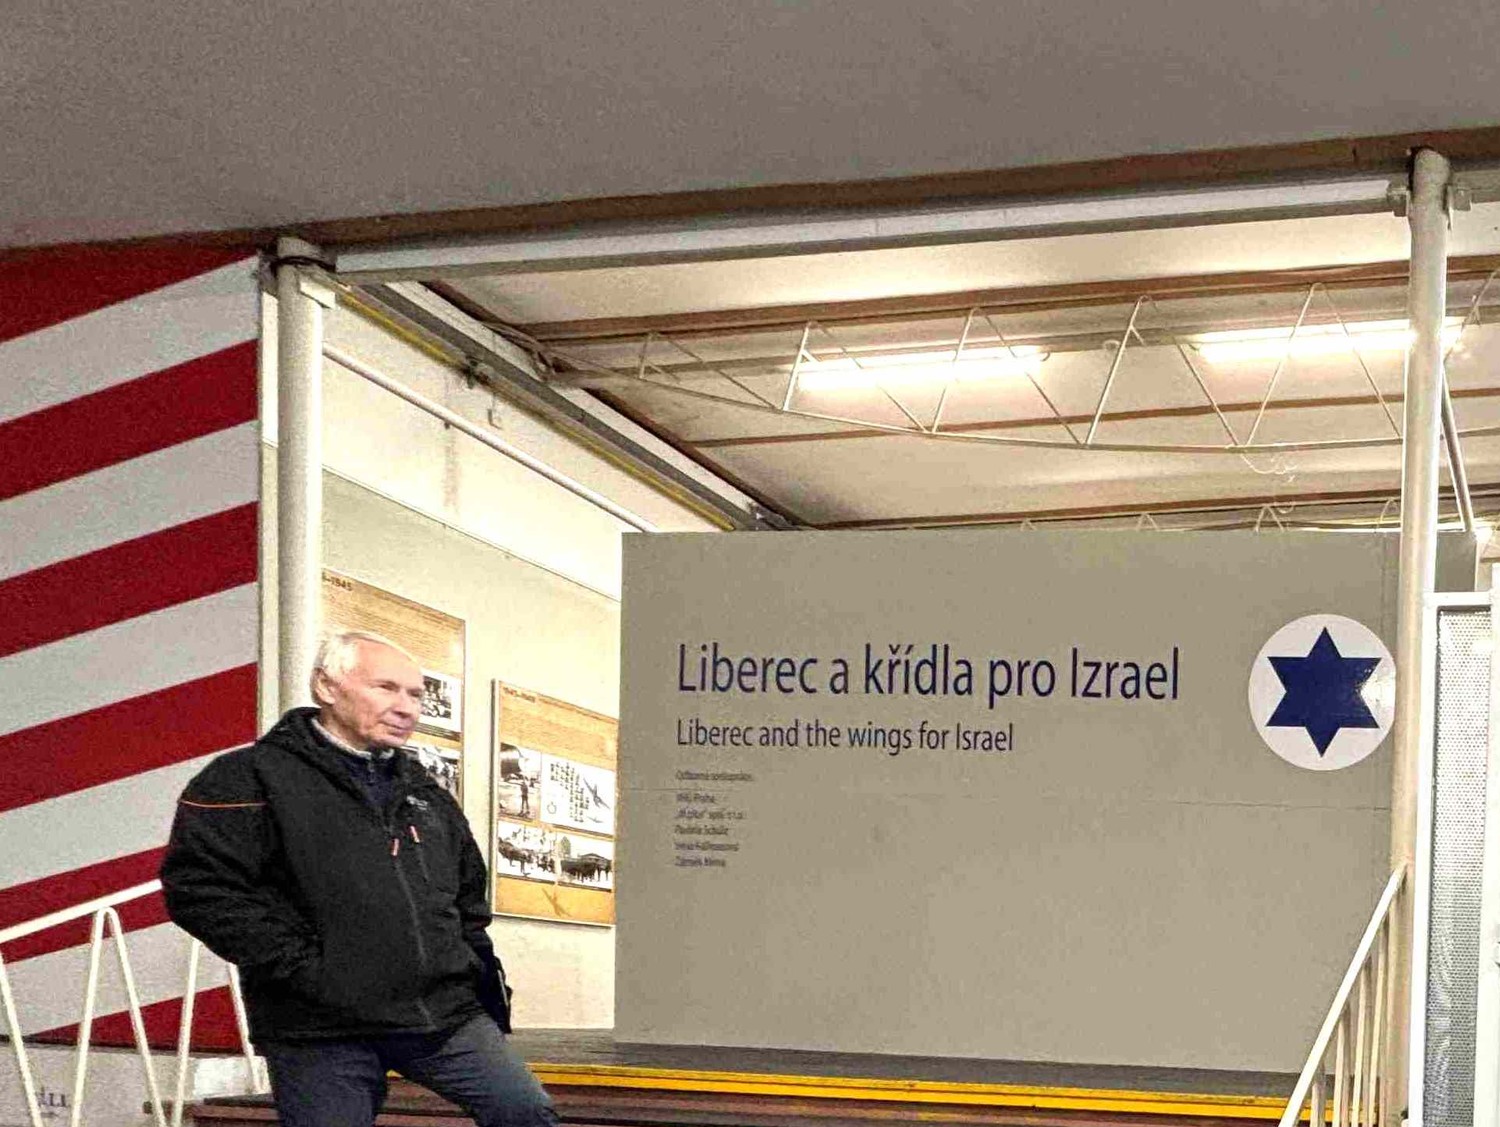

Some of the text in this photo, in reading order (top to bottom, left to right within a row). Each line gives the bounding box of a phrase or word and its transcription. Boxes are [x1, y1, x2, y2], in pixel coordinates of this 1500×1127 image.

[678, 641, 1179, 710] Liberec a křídla pro Izrael
[677, 717, 1013, 756] Liberec and the wings for Israel
